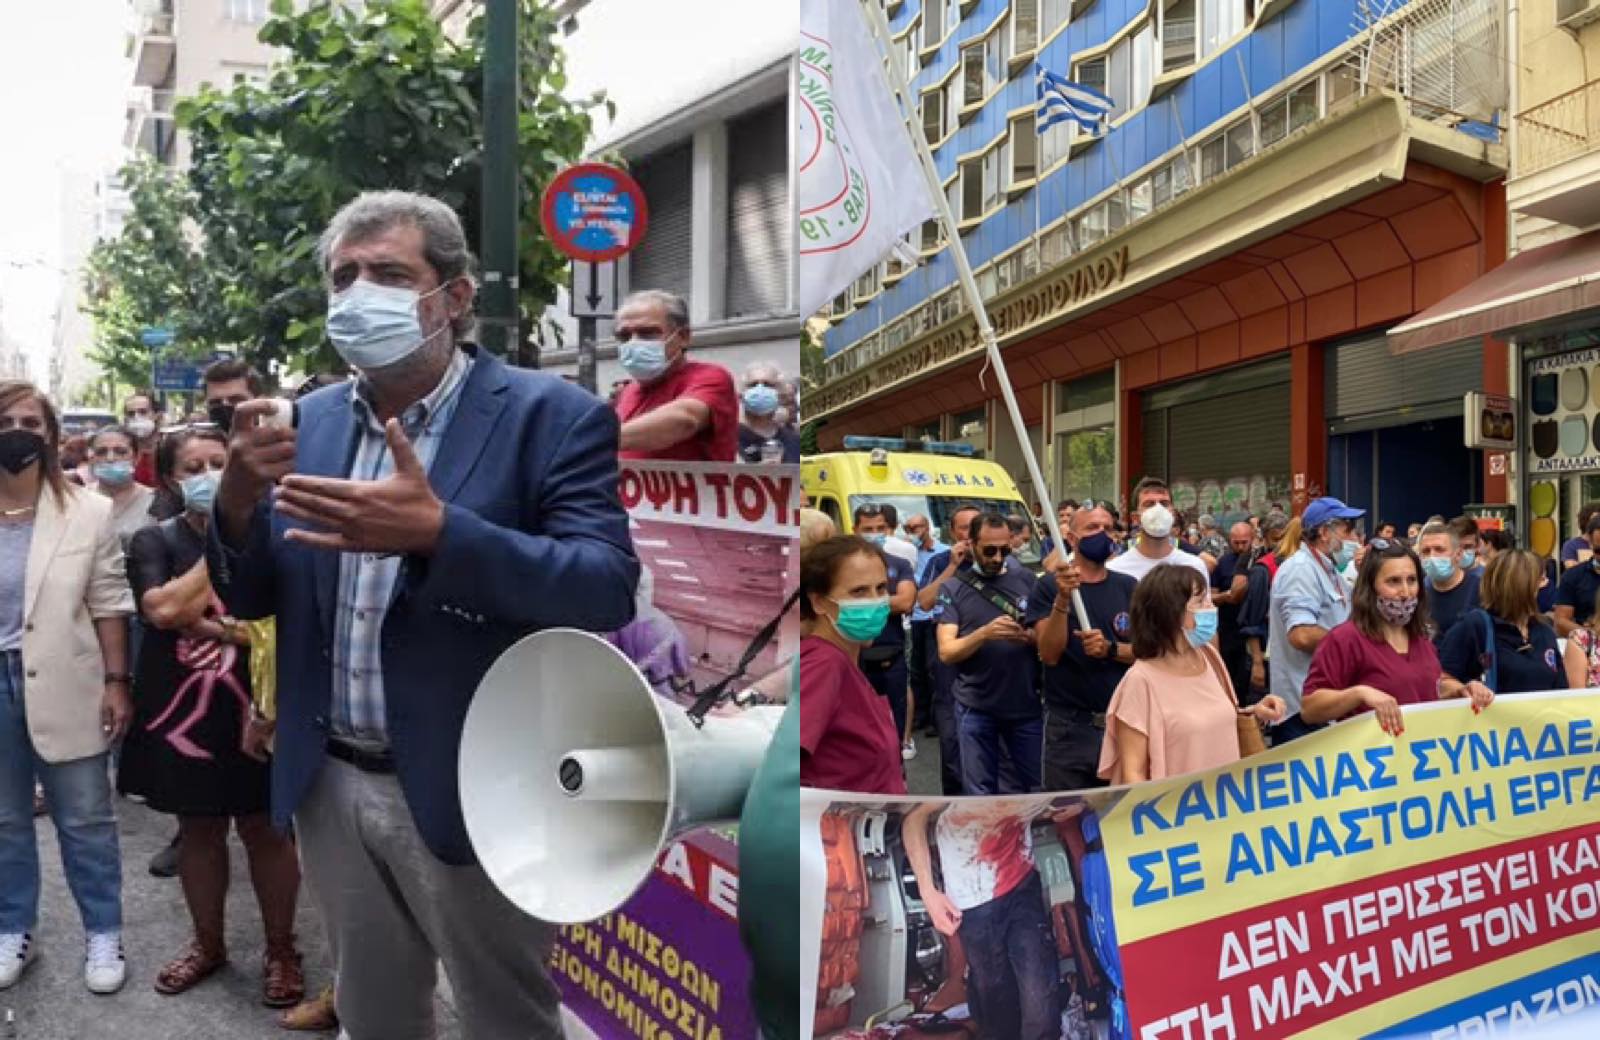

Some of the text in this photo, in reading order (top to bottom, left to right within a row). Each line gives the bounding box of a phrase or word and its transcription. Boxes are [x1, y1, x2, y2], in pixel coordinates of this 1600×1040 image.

[1127, 764, 1600, 907] ΣΕ ΑΝΑΣΤΟΛΗ ΕΡΓΑ
[1132, 719, 1600, 835] ΚΑΝΕΝΑΣ ΣΥΝΑΔΕ
[618, 913, 719, 1014] ΜΙΣΘΩΝ
[1217, 834, 1600, 980] ΔΕΝ ΠΕΡΙΣΣΕΥΕΙ ΚΑ
[1249, 946, 1380, 1031] ΜΑΧΗ
[1391, 924, 1452, 978] ΜΕ
[1460, 898, 1537, 953] ΤΟΝ
[1545, 880, 1600, 928] ΚΟ
